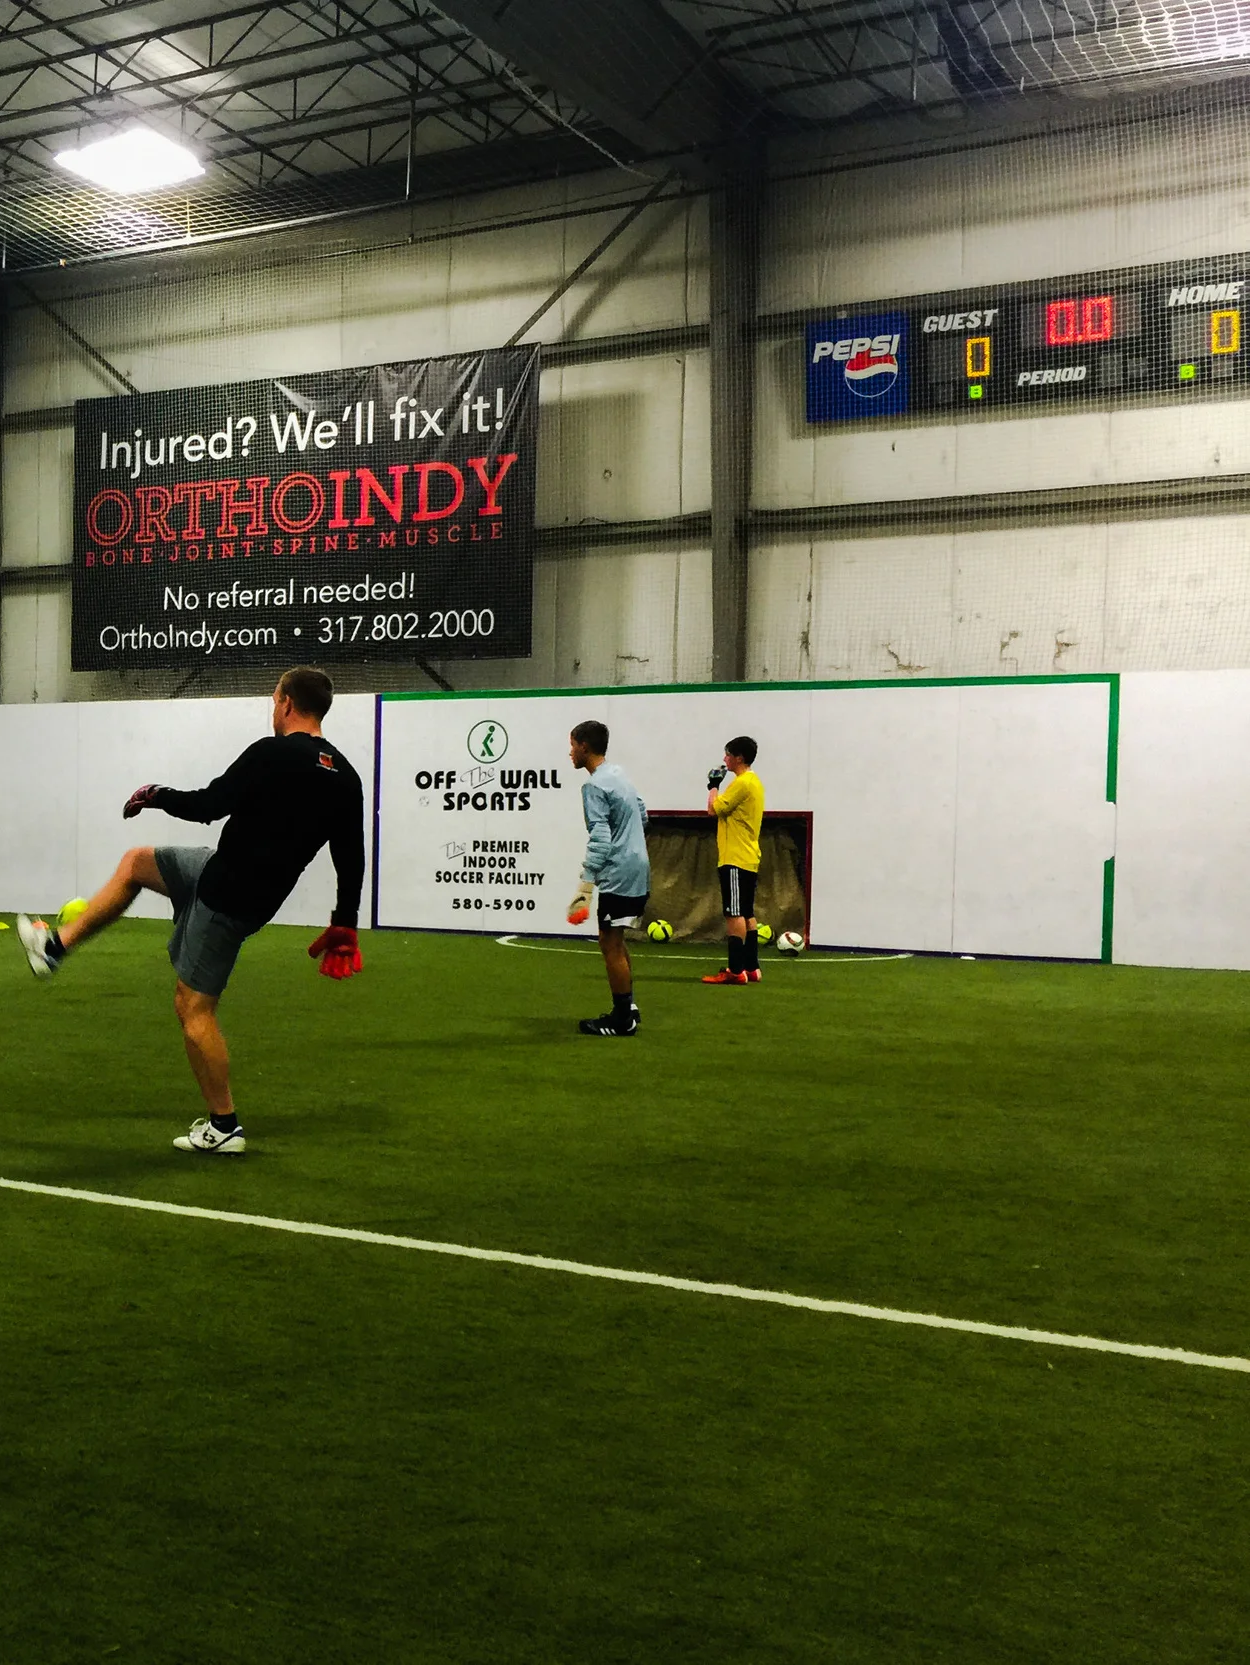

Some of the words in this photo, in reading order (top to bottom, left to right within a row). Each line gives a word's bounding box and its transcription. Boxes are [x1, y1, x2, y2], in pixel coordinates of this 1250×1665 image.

[1168, 281, 1245, 307] HOME
[923, 308, 999, 333] GUEST
[1211, 309, 1240, 355] 0
[812, 333, 900, 364] PEPSI
[966, 336, 991, 378] 0
[1017, 366, 1087, 387] PERIOD
[100, 416, 257, 479] Injured?
[270, 400, 375, 454] We'll
[390, 395, 445, 442] fix
[461, 387, 503, 434] it!
[86, 452, 518, 546] ORTHOINDY
[163, 586, 199, 611] No
[207, 579, 294, 608] referral
[303, 572, 416, 604] needed!
[99, 621, 277, 654] OrthoIndy.com
[317, 608, 494, 643] 317.802.2000
[415, 770, 456, 790] OFF
[460, 766, 495, 788] The
[500, 769, 561, 789] WALL
[443, 791, 531, 811] SPORTS
[440, 841, 466, 857] The
[472, 840, 530, 853] PREMIER
[463, 856, 516, 869] INDOOR
[435, 871, 483, 884] SOCCER
[489, 872, 545, 885] FACILITY
[452, 898, 535, 911] 580-5900
